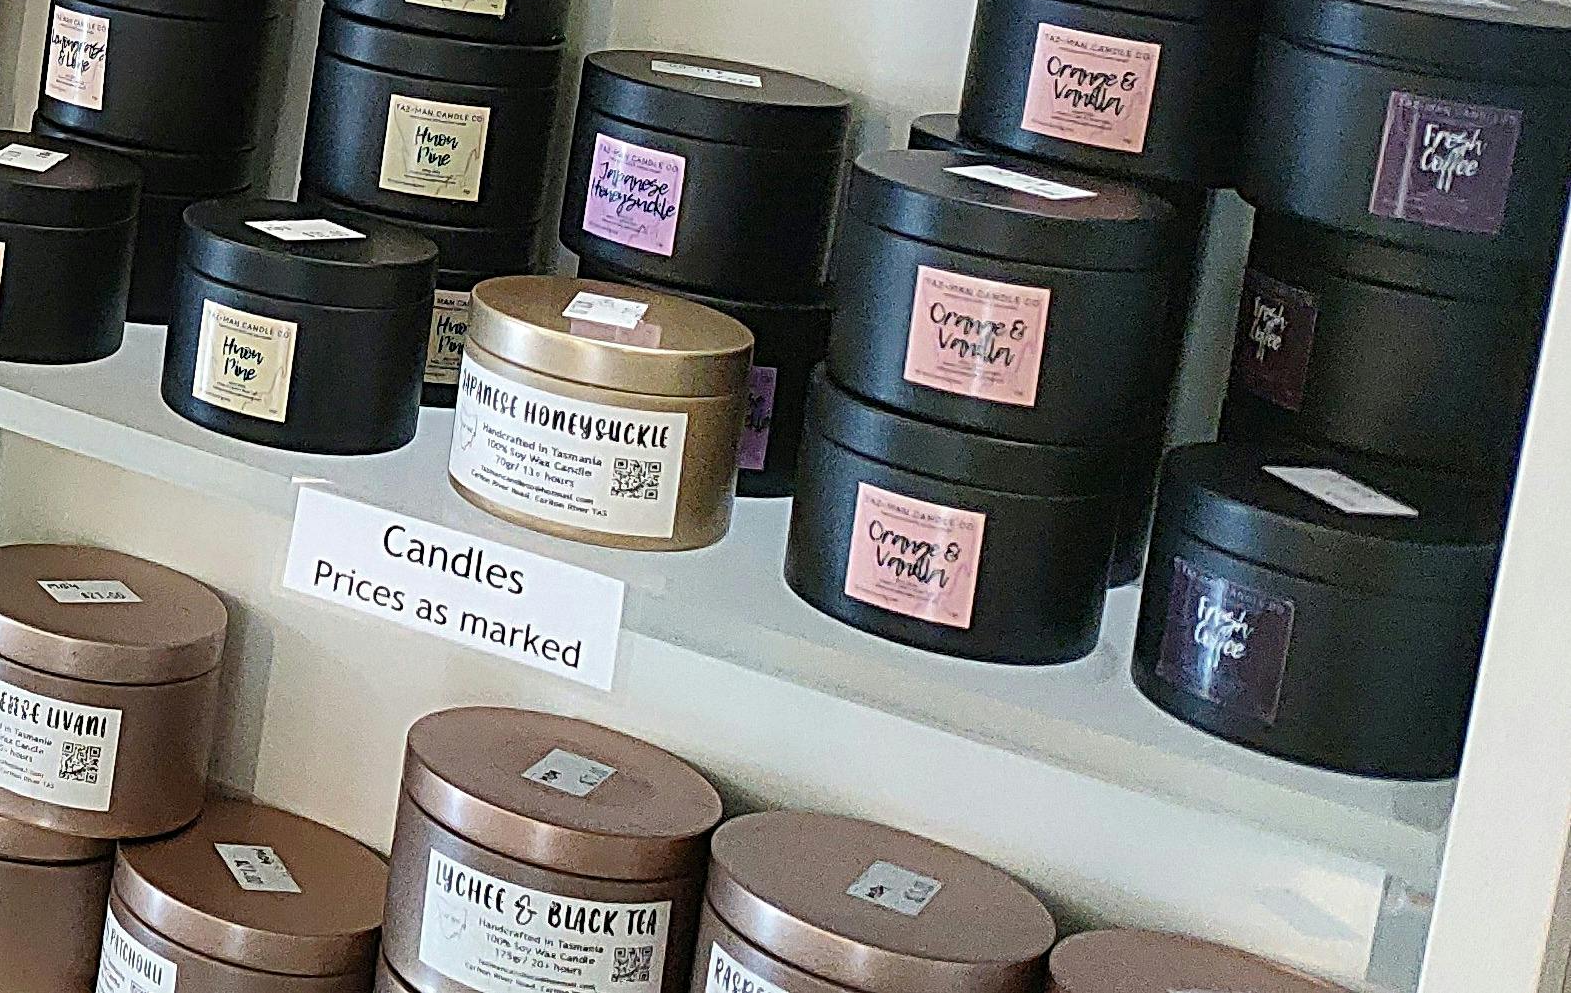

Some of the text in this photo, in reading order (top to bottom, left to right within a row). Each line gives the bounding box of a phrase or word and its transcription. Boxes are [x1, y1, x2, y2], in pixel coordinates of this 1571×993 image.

[1046, 55, 1138, 91] Orange &
[1053, 78, 1125, 117] Vanilla
[436, 109, 484, 123] CANDLE CO
[414, 125, 459, 150] Huon
[1422, 121, 1487, 158] Fresh
[416, 146, 452, 167] Pine
[1419, 147, 1481, 193] Coffee
[222, 335, 264, 365] Huon
[223, 357, 258, 381] Pine
[524, 400, 670, 450] HONEYSUCKLE
[482, 421, 603, 468] Handcrafted in Tasmania
[510, 443, 593, 478] Soy Wax Candle
[544, 470, 575, 488] hours
[383, 524, 525, 596] Candles
[313, 558, 582, 669] Prices as marked
[435, 860, 657, 937] LYCHEE & BLACK TEA
[479, 916, 604, 954] Handcrafted in Tasmania
[534, 947, 557, 959] Wax
[559, 950, 596, 965] Candle
